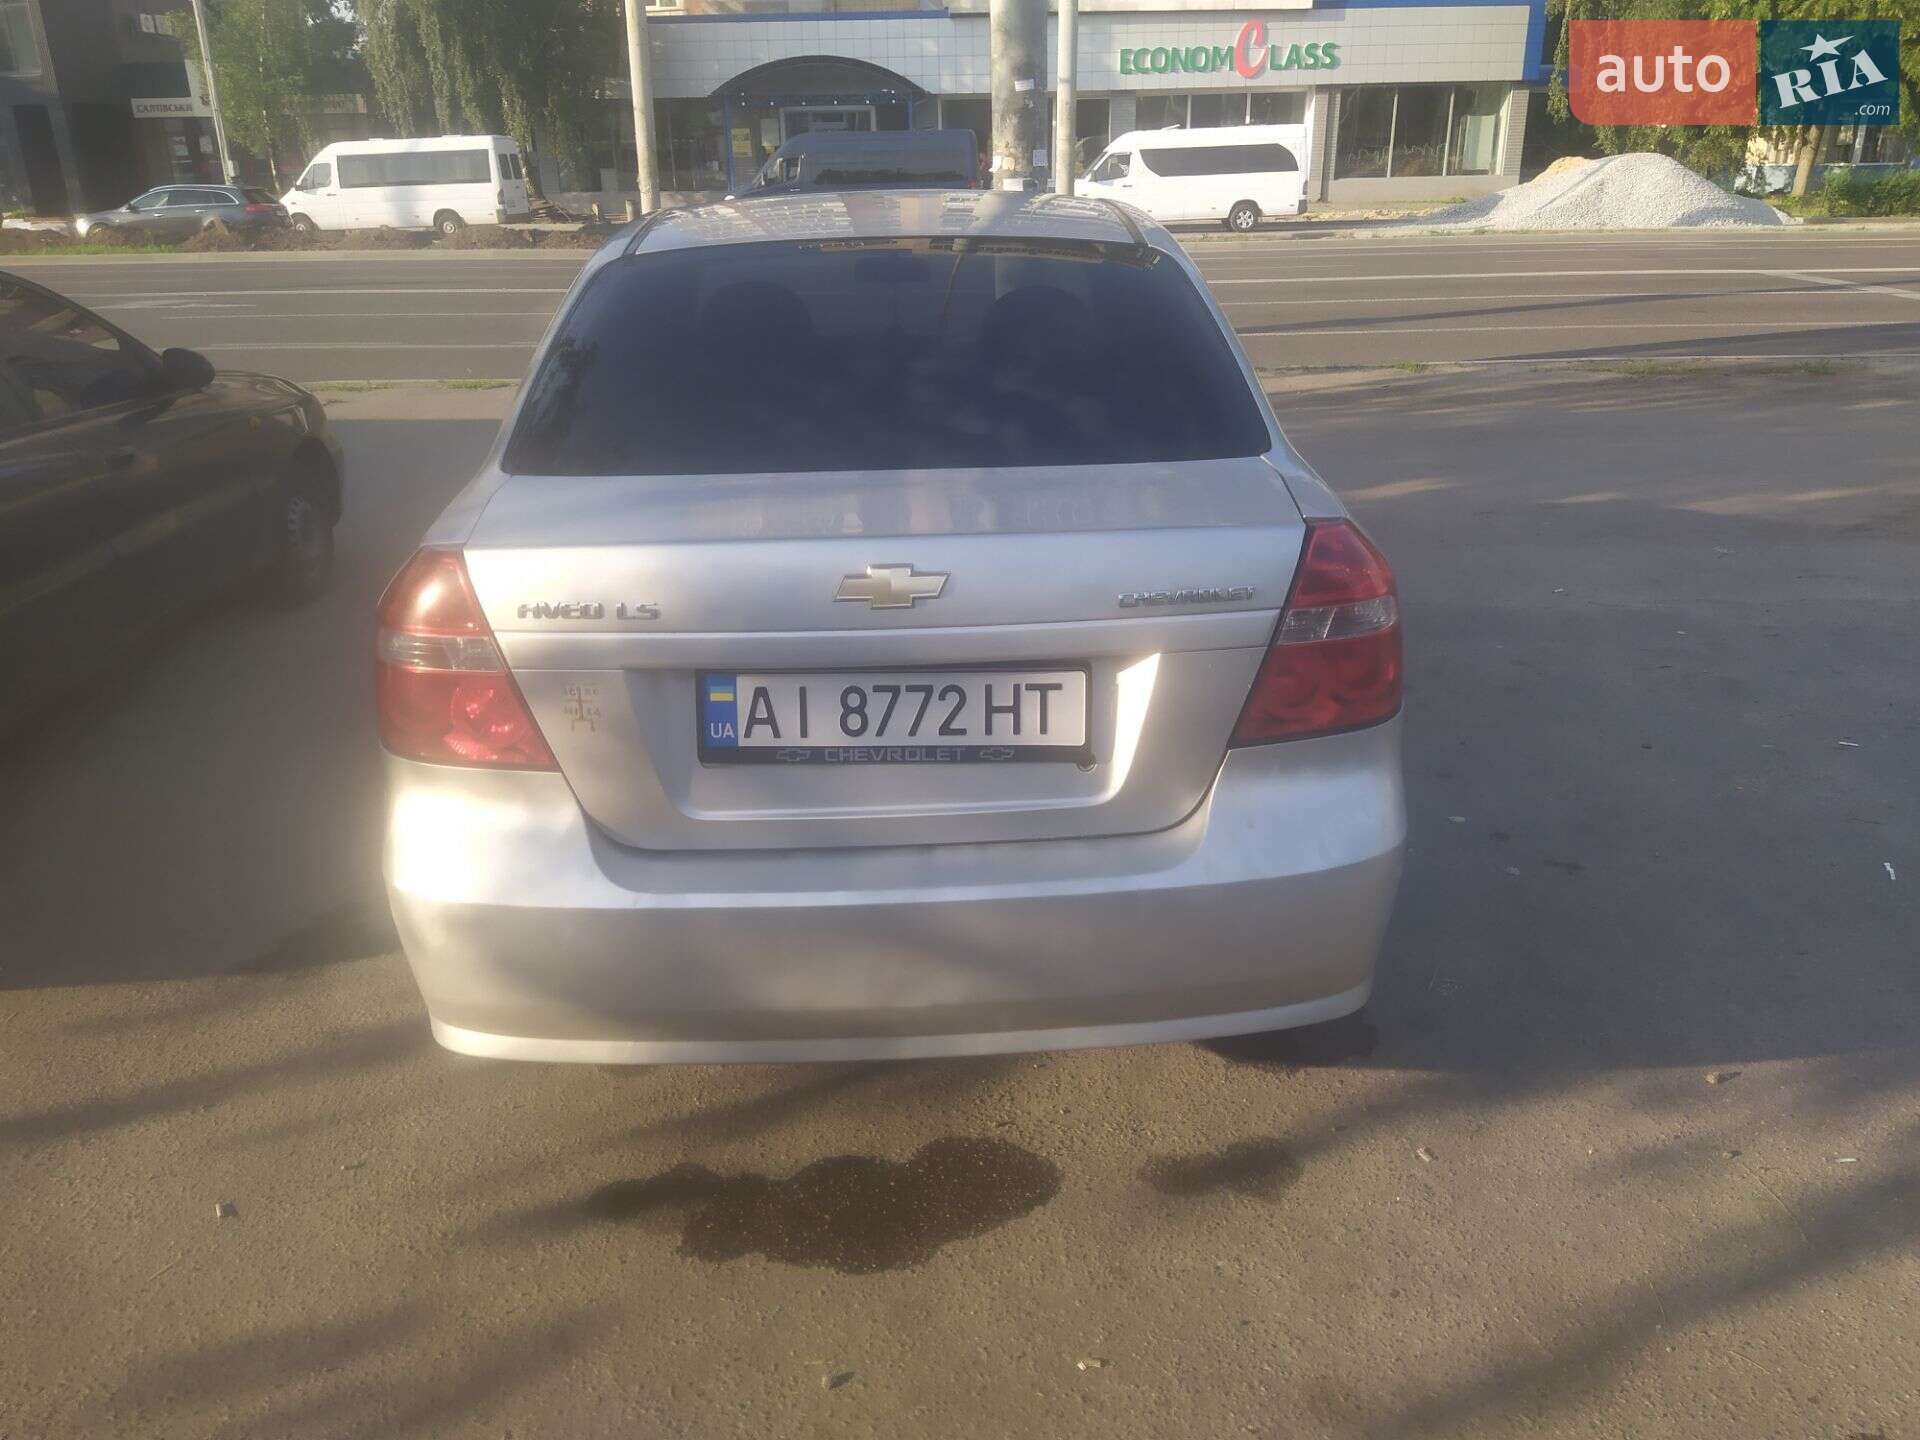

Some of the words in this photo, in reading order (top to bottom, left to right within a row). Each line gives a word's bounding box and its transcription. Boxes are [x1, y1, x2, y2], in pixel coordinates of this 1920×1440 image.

[1118, 585, 1256, 608] CHEVROLET
[517, 601, 605, 620] AVEO
[615, 601, 661, 620] LS
[743, 686, 808, 739] AI
[839, 683, 968, 738] 8772
[984, 682, 1063, 737] HT
[710, 723, 735, 739] UA
[824, 746, 967, 762] CHEVROLET
